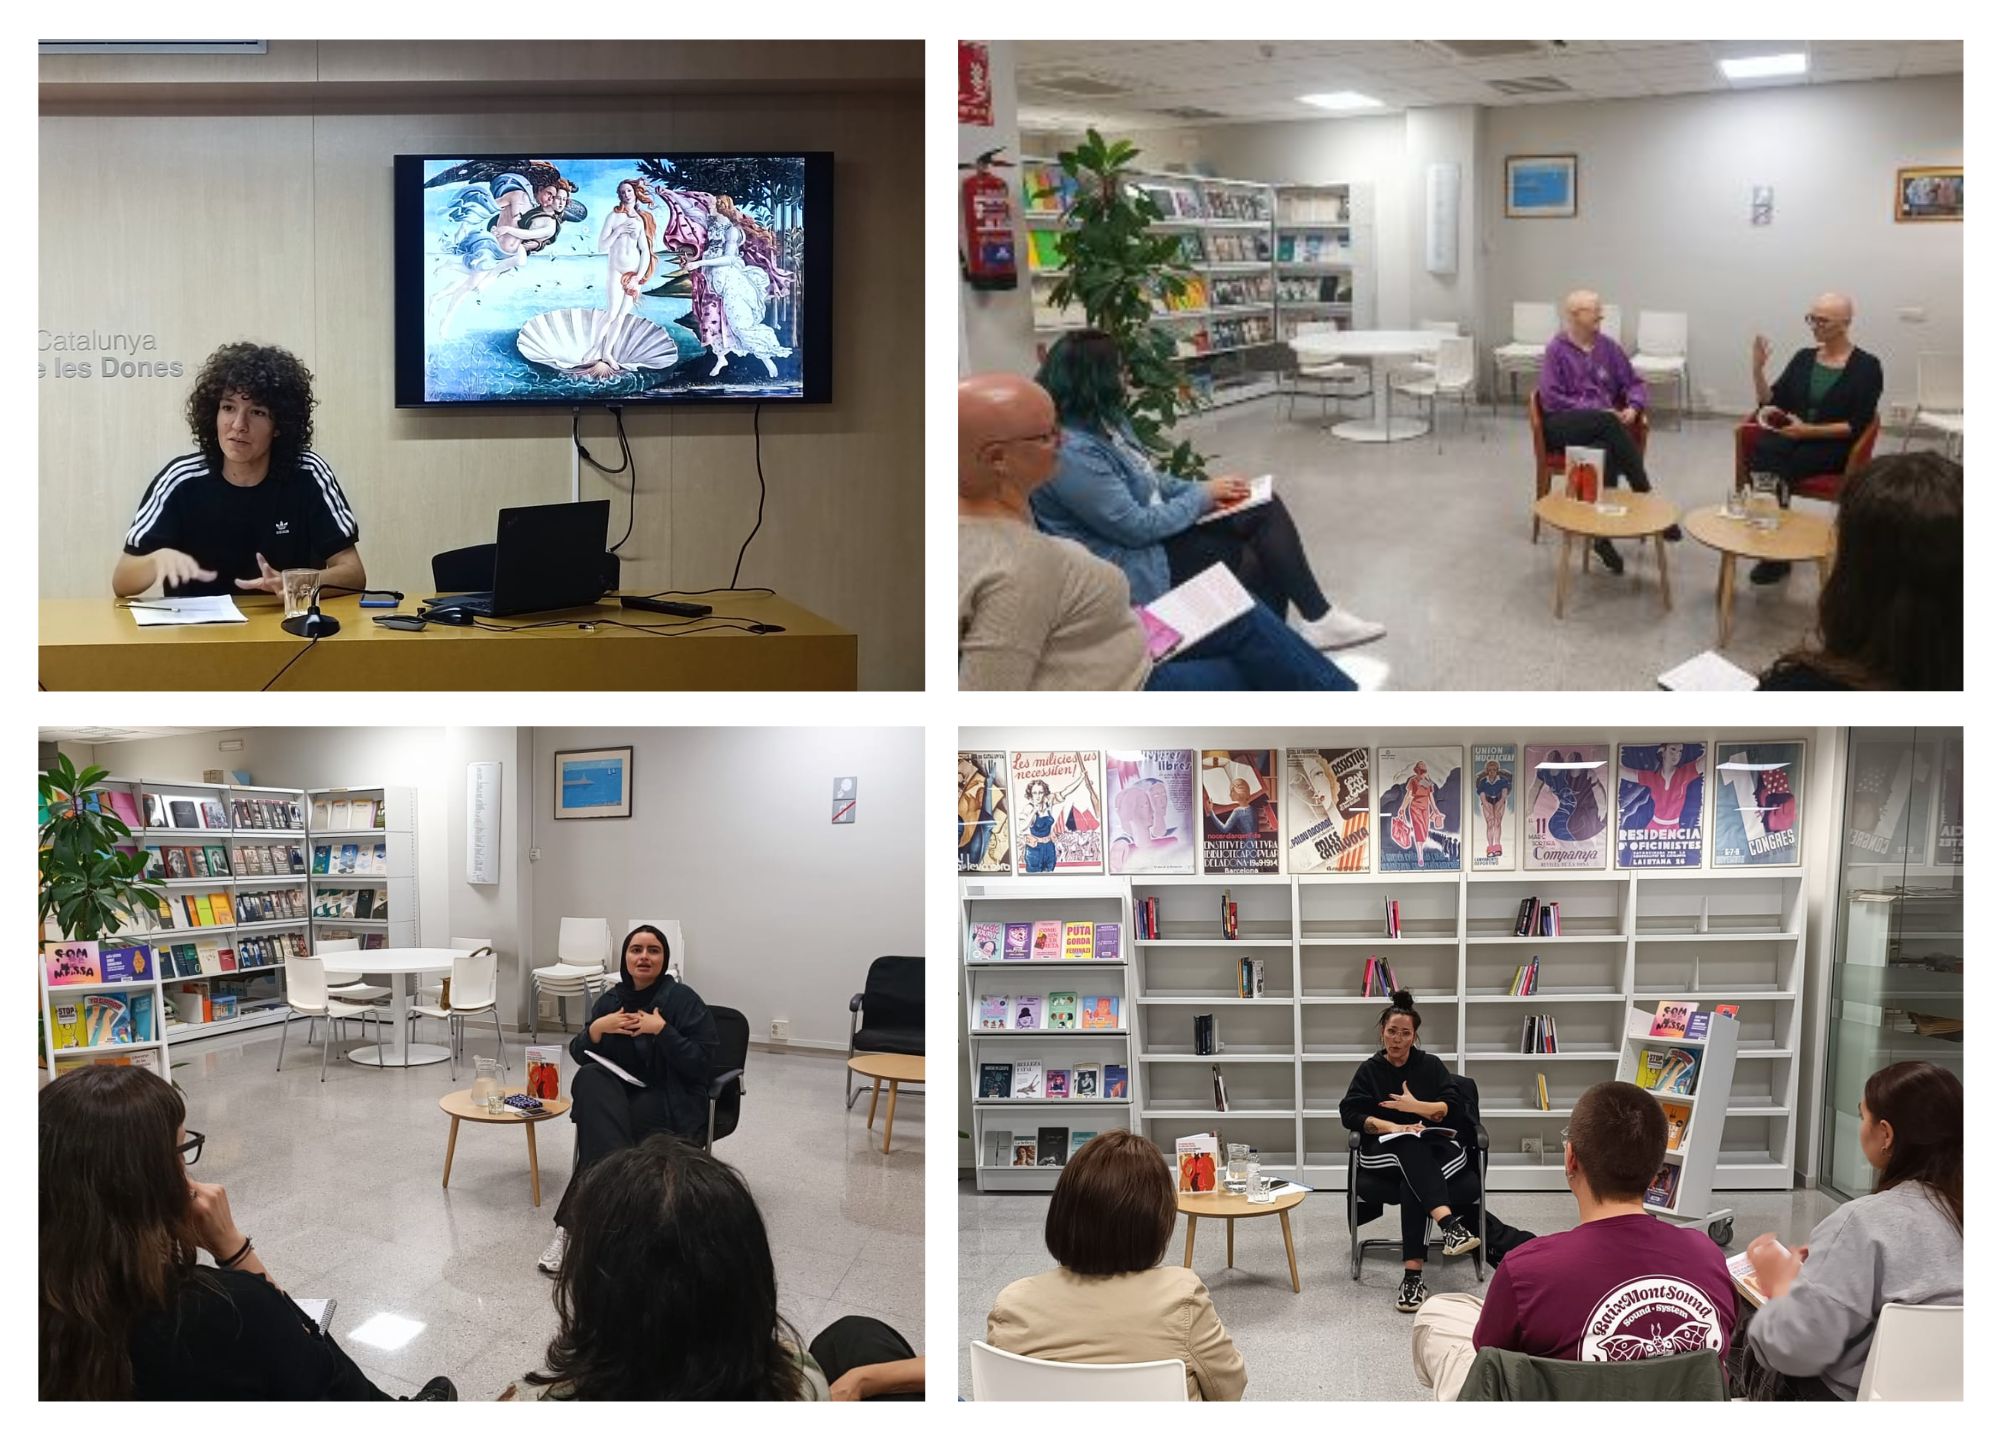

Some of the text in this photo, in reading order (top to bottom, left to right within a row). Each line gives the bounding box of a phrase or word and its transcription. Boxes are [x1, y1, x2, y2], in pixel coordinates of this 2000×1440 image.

[38, 329, 157, 356] Catalunya
[54, 357, 92, 379] les
[101, 356, 184, 378] Dones
[1475, 746, 1503, 754] UNION
[1012, 751, 1097, 770] Les milicies us
[1158, 760, 1192, 771] libres
[1314, 831, 1341, 853] MISS
[1319, 826, 1369, 860] CATALUNYA
[1619, 828, 1701, 841] RESIDENCIA
[1748, 829, 1796, 856] CONGRES
[1533, 846, 1598, 863] Companya
[1067, 925, 1091, 936] PUTA
[1066, 937, 1091, 946] GORDA
[58, 1007, 75, 1015] STOP
[1592, 1285, 1713, 1337] BaixMontSound
